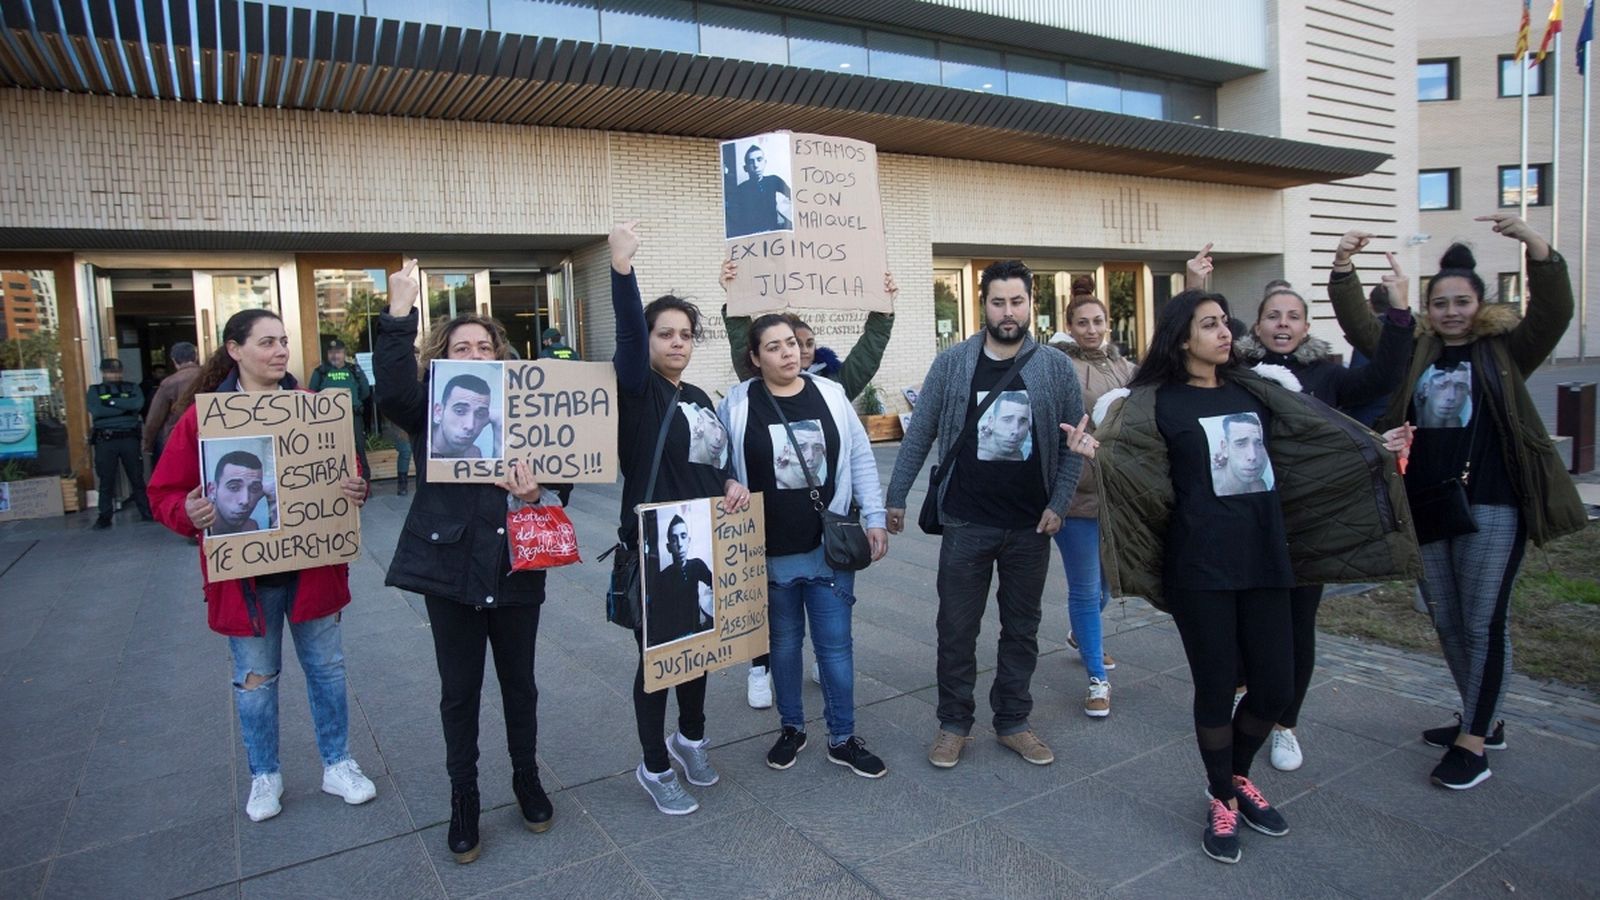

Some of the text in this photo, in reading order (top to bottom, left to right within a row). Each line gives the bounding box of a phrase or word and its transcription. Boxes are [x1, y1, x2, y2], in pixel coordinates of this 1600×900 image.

[795, 139, 866, 162] ESTAMOS
[800, 166, 856, 188] TODOS
[796, 189, 841, 206] CON
[798, 211, 867, 230] MAIQUEL
[731, 238, 847, 261] EXIGIMOS
[754, 272, 864, 297] JUSTICIA
[508, 364, 545, 390] NO
[203, 392, 350, 429] ASESINOS
[508, 387, 609, 419] ESTABA
[278, 428, 309, 457] NO
[509, 423, 575, 449] SOLO
[280, 454, 350, 490] ESTABA
[283, 497, 349, 527] SOLO
[714, 518, 755, 541] TENIA
[210, 530, 359, 573] TE QUEREMOS
[724, 543, 748, 566] 24
[718, 572, 737, 588] NO
[718, 586, 763, 611] MERECIA
